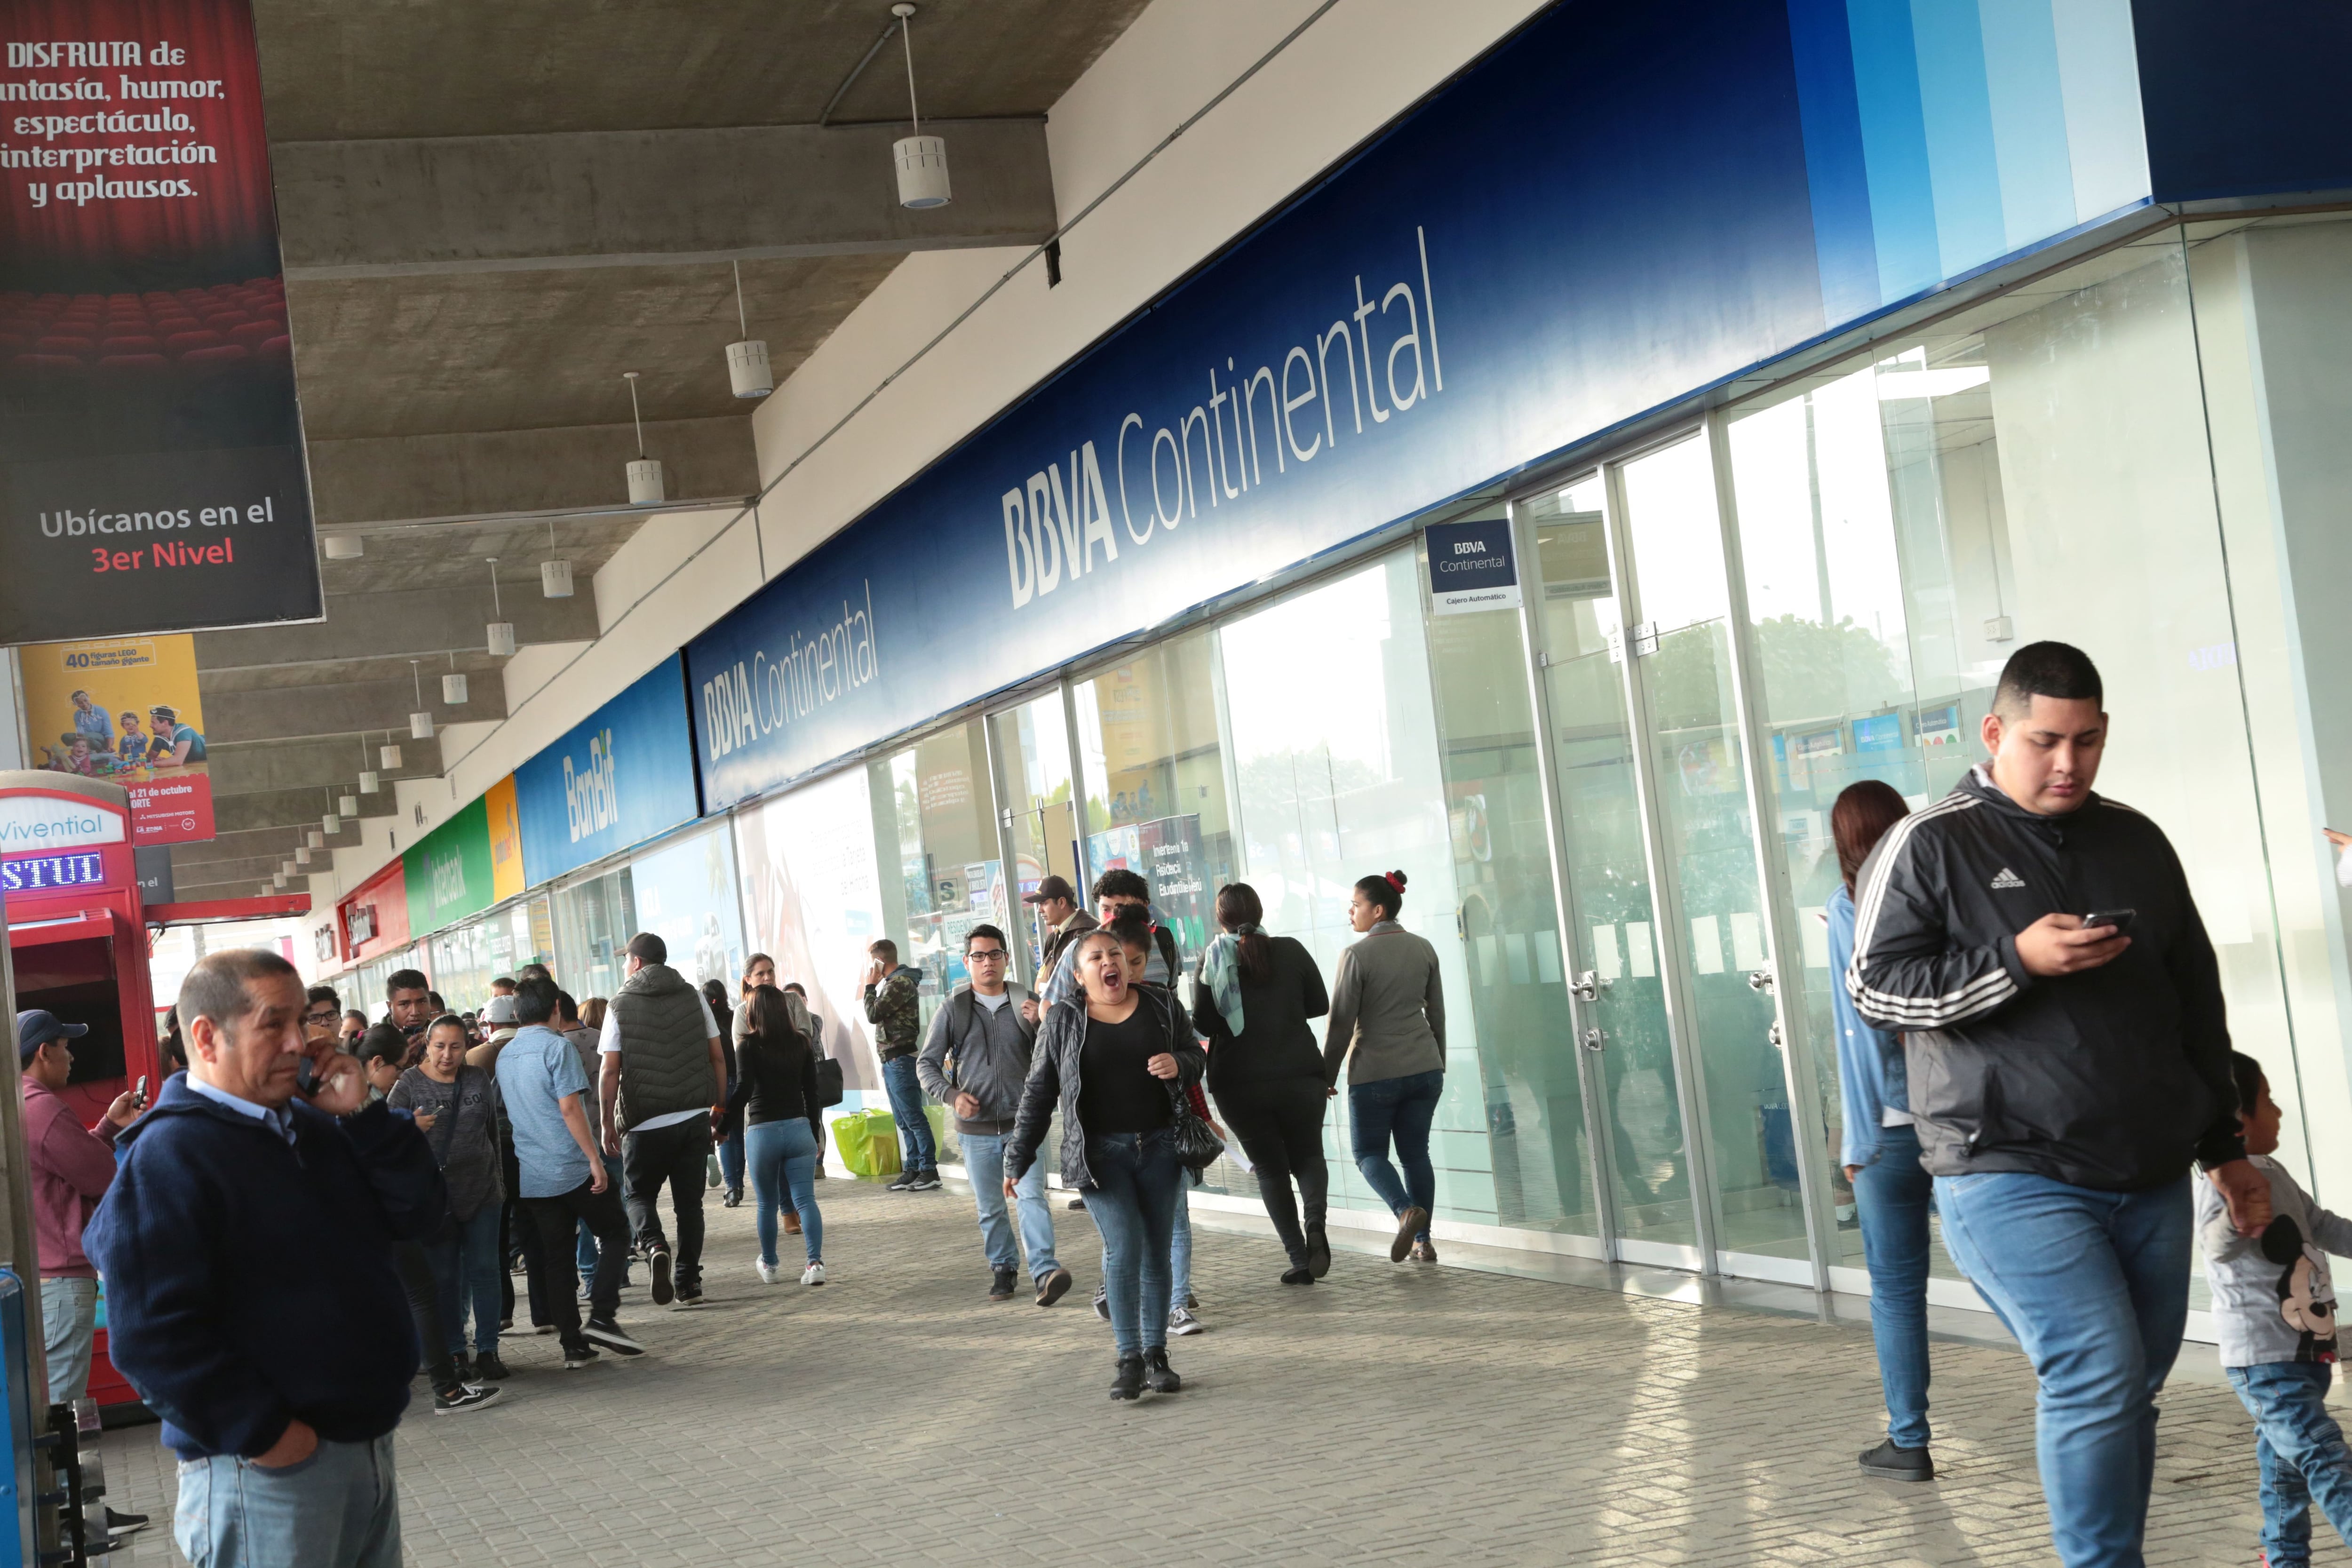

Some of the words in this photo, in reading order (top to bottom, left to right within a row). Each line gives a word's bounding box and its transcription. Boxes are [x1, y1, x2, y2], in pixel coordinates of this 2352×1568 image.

[7, 42, 142, 68] DISFRUTA
[150, 41, 185, 65] de
[0, 77, 111, 102] ntasía,
[119, 75, 225, 100] humor,
[14, 107, 195, 141] espectáculo,
[0, 140, 217, 173] interpretación
[29, 183, 47, 207] y
[56, 175, 198, 207] aplausos.
[1001, 439, 1118, 610] BBVA
[1118, 226, 1443, 545] Continental
[40, 508, 191, 537] Ubícanos
[199, 506, 238, 526] en
[247, 497, 273, 523] el
[92, 547, 143, 573] 3er
[152, 537, 233, 567] Nivel
[1454, 541, 1486, 554] BBVA
[1440, 556, 1505, 572] Continental
[1469, 594, 1506, 603] Automático
[66, 653, 89, 668] 40
[90, 652, 116, 661] figuras
[122, 656, 149, 666] gigante
[703, 661, 756, 762] BBVA
[753, 578, 878, 734] Continental
[129, 790, 136, 798] al
[137, 788, 147, 797] 21
[149, 788, 159, 796] de
[160, 785, 192, 795] octubre
[564, 728, 618, 843] BanBif
[131, 798, 151, 808] ORTE
[0, 814, 102, 841] Vivential
[148, 877, 158, 887] el
[1991, 880, 2026, 889] adidas
